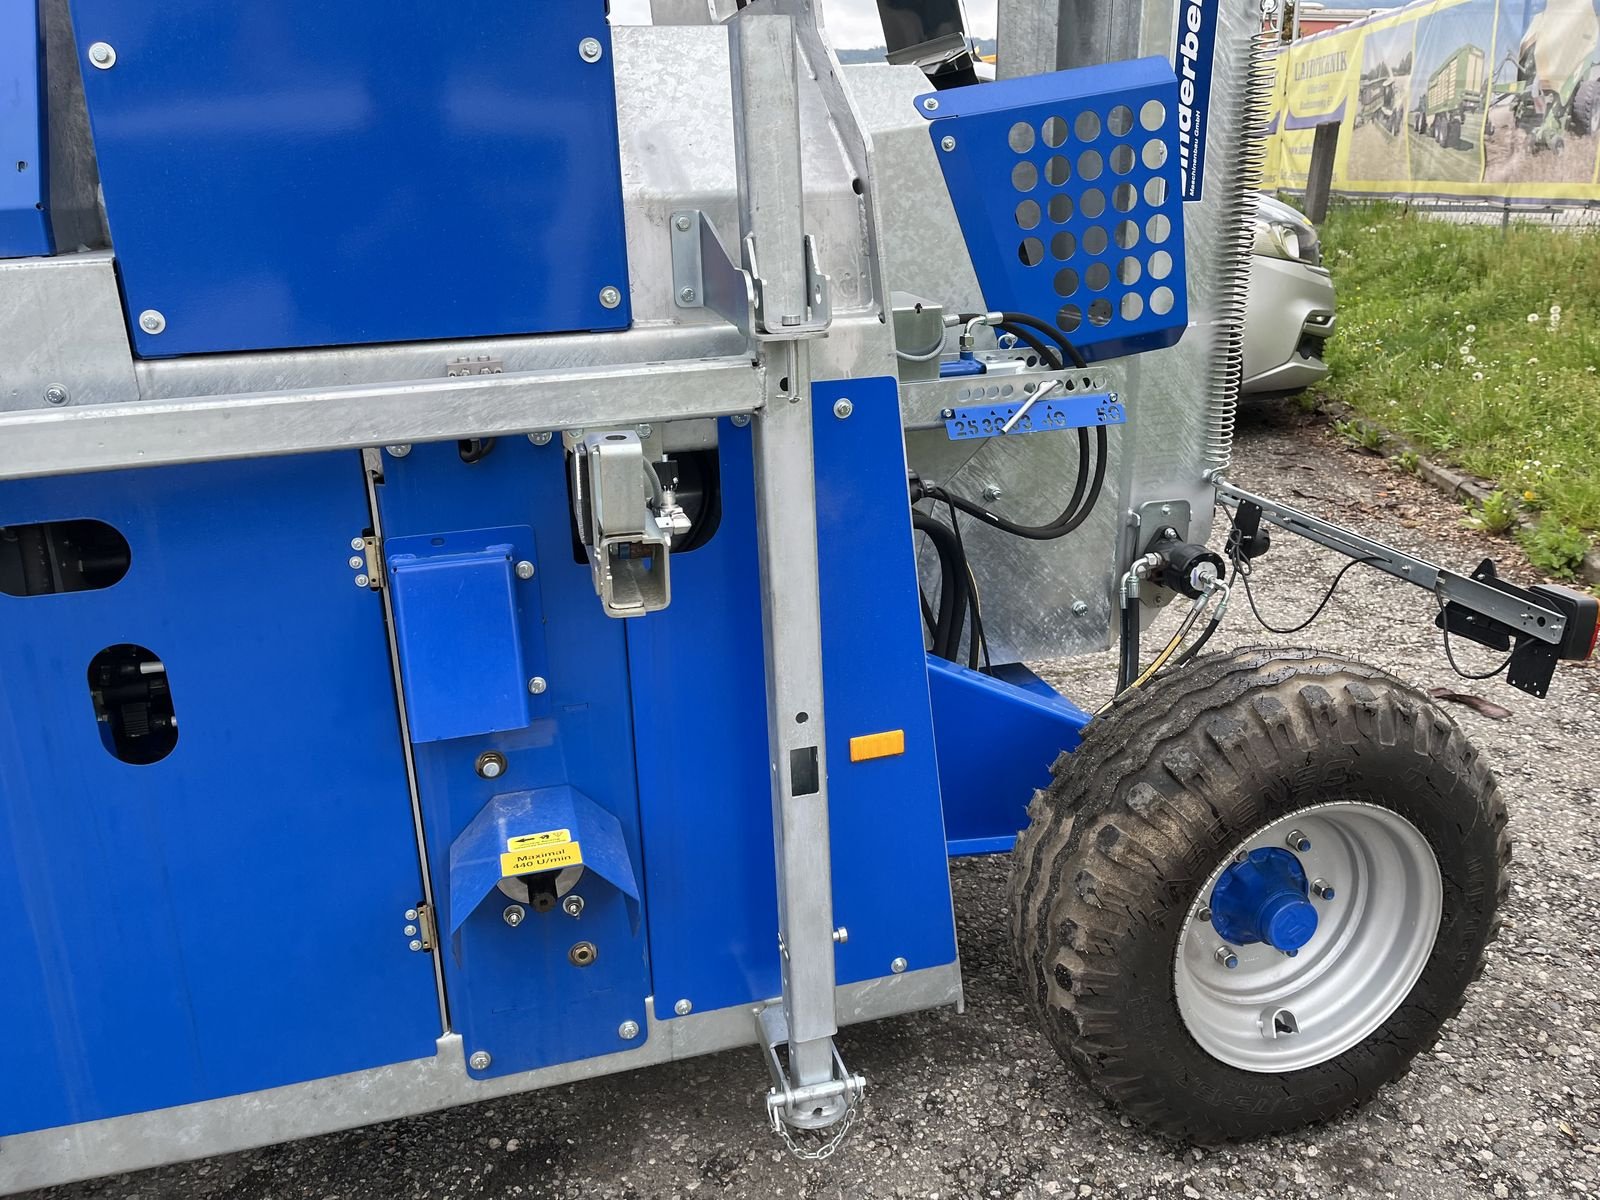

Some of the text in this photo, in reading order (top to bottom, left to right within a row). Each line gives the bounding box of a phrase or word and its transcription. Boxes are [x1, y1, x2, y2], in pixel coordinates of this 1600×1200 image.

[1179, 0, 1203, 197] nderbe
[1190, 138, 1199, 197] Maschinenbau
[954, 419, 979, 436] 25
[1096, 405, 1120, 422] 50
[512, 855, 571, 869] 440 U/min
[517, 849, 565, 862] Maximal
